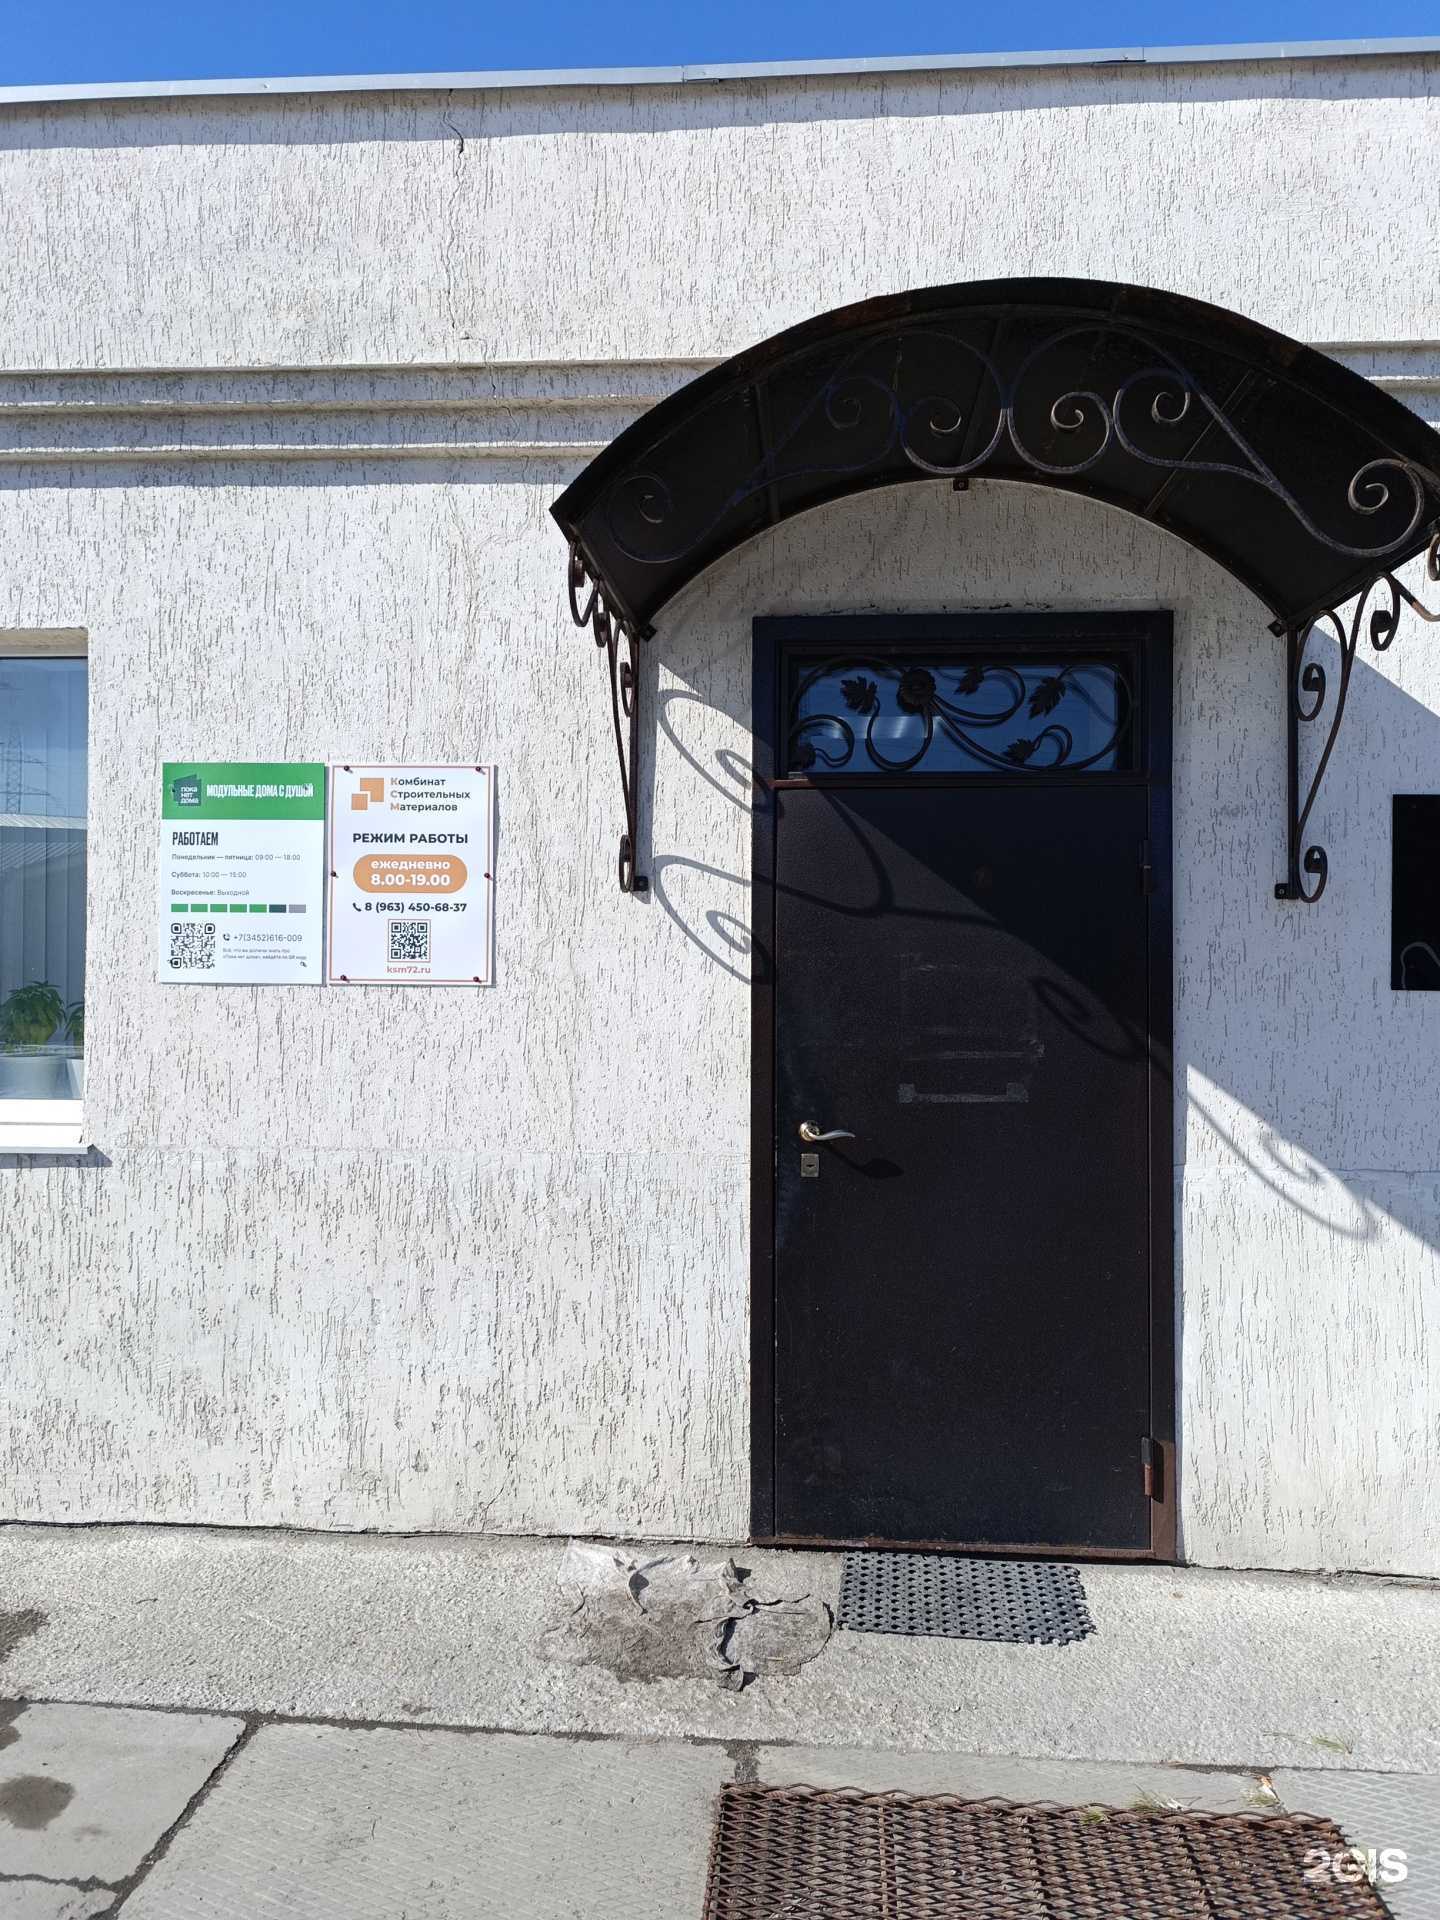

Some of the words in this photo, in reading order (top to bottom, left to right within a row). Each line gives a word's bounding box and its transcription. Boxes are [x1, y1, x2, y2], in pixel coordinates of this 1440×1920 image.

[390, 777, 446, 786] Комбинат
[206, 784, 254, 798] МОДУЛЬНЫЕ
[255, 784, 278, 798] ДОМА
[278, 785, 284, 796] С
[285, 783, 314, 798] ДУШОЙ
[390, 790, 470, 800] Строительных
[390, 803, 458, 812] Материалов
[172, 832, 218, 846] РАБОТАЕМ
[352, 834, 405, 843] РЕЖИМ
[410, 834, 468, 843] РАБОТЫ
[371, 860, 450, 870] ежедневно
[371, 874, 450, 886] 8.00-19.00
[365, 903, 372, 911] 8
[376, 902, 404, 913] (963)
[408, 903, 467, 912] 450-68-37
